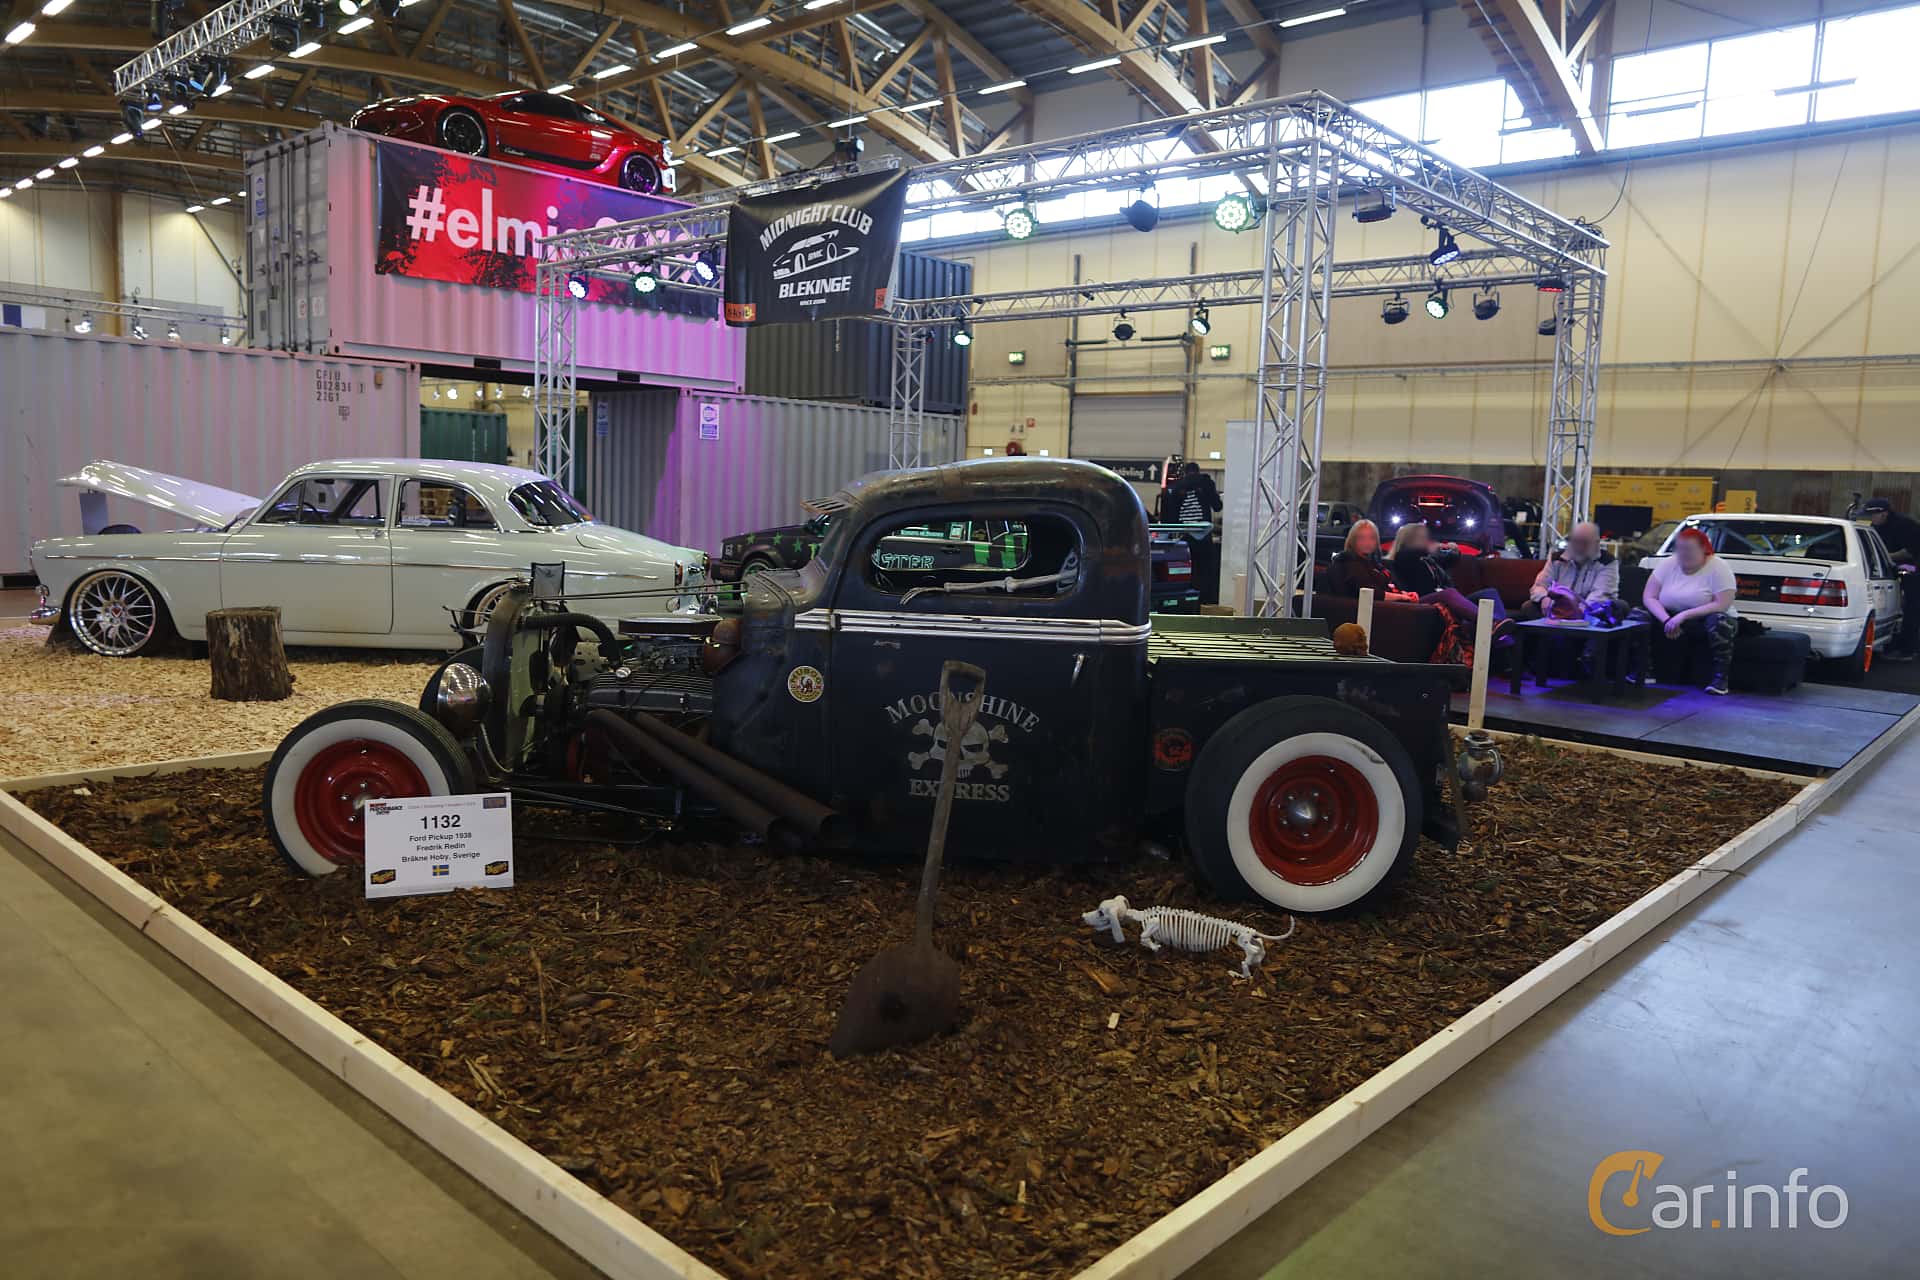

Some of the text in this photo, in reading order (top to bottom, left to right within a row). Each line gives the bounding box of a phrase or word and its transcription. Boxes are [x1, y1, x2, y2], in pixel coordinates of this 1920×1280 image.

[759, 204, 873, 251] MIDNIGHT CLUB
[778, 275, 852, 299] BLEKINGE
[909, 778, 1010, 802] EXRESS
[421, 814, 461, 830] 1132
[428, 833, 454, 842] Pickup
[453, 851, 481, 860] Sverige
